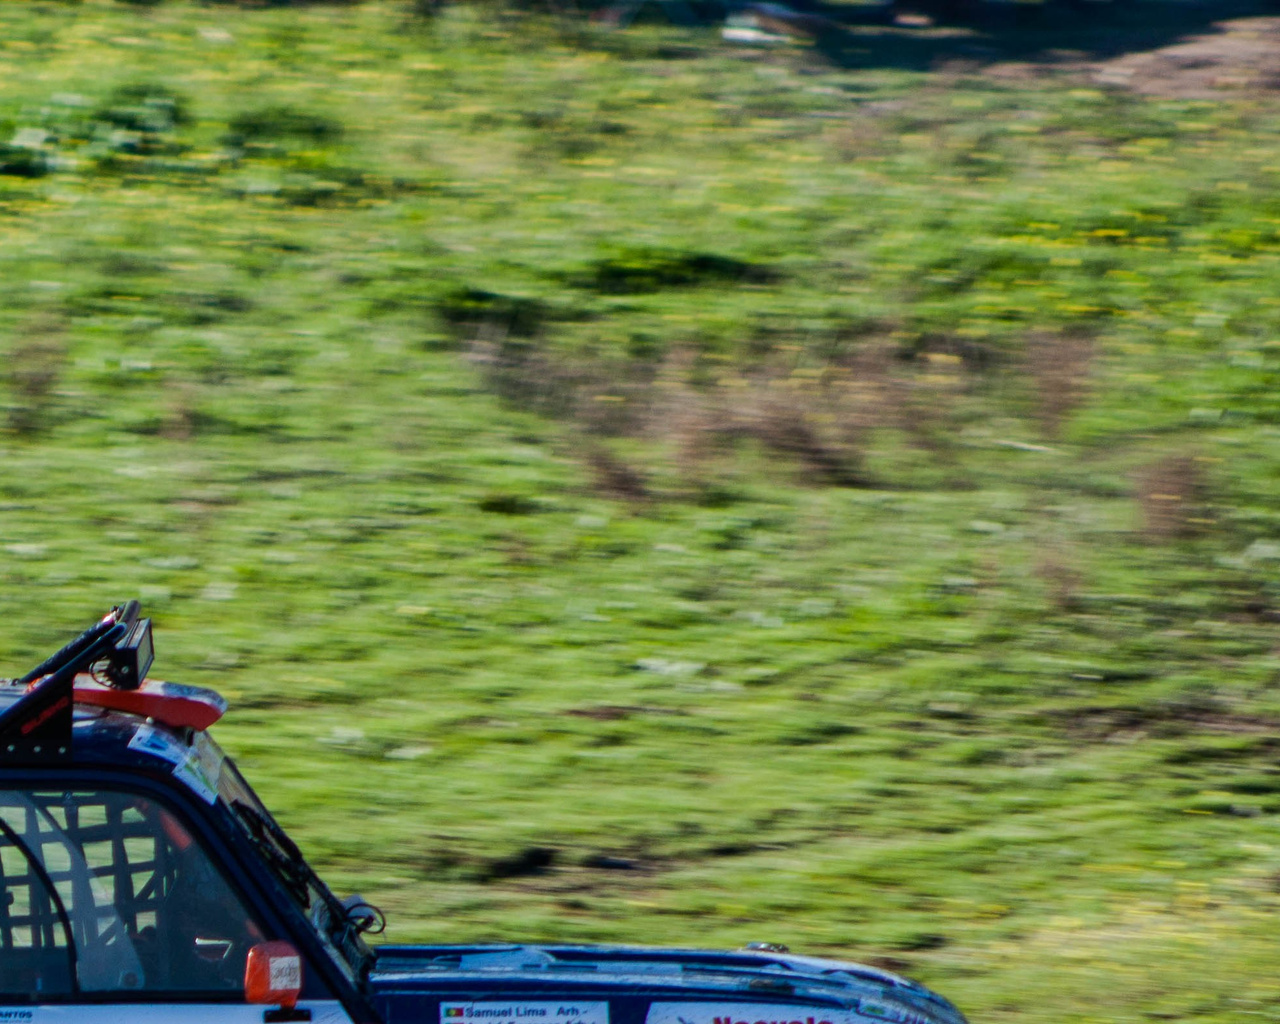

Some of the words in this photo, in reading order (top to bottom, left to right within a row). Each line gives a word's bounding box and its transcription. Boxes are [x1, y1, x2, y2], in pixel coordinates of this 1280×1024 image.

[465, 1006, 512, 1018] Samuel
[516, 1007, 547, 1017] Lima
[557, 1006, 579, 1015] Arh
